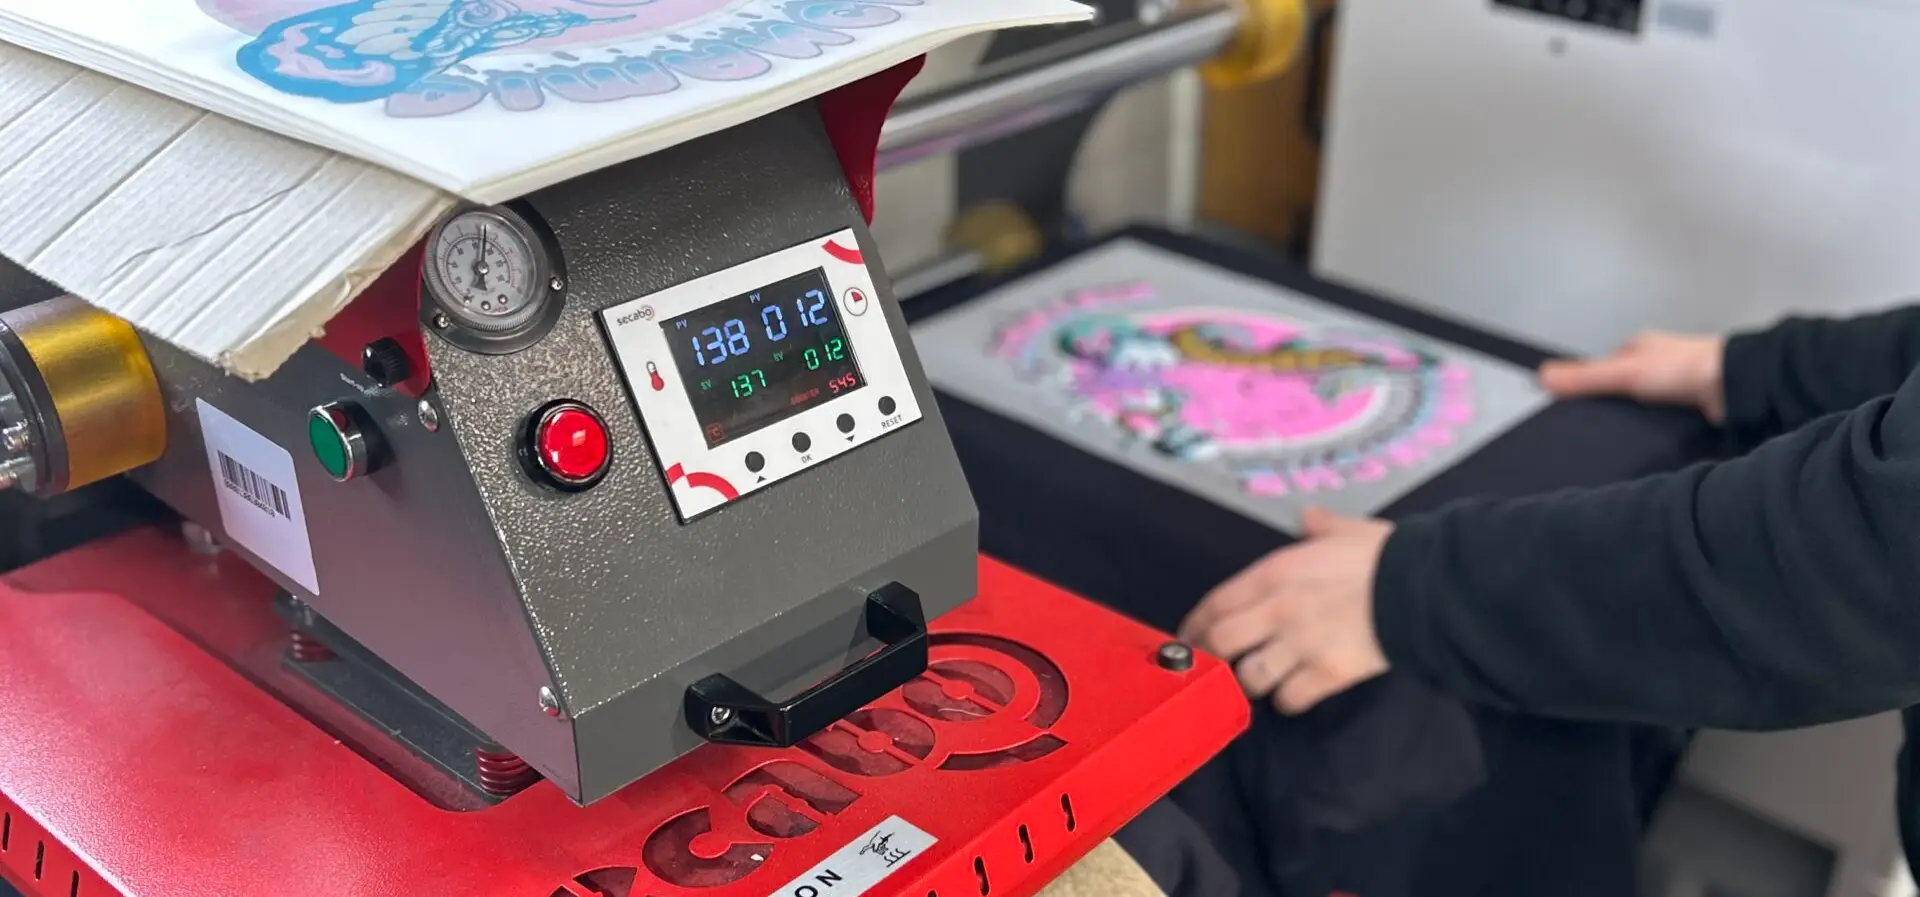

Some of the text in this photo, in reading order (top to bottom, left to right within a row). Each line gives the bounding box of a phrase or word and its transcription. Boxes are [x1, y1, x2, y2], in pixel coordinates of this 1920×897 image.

[749, 292, 760, 304] PV
[616, 307, 654, 327] secabo
[676, 319, 687, 330] PV
[692, 318, 750, 366] 138
[731, 369, 767, 399] 137
[828, 372, 857, 394] 545
[881, 414, 903, 429] RESET
[801, 454, 813, 464] OK
